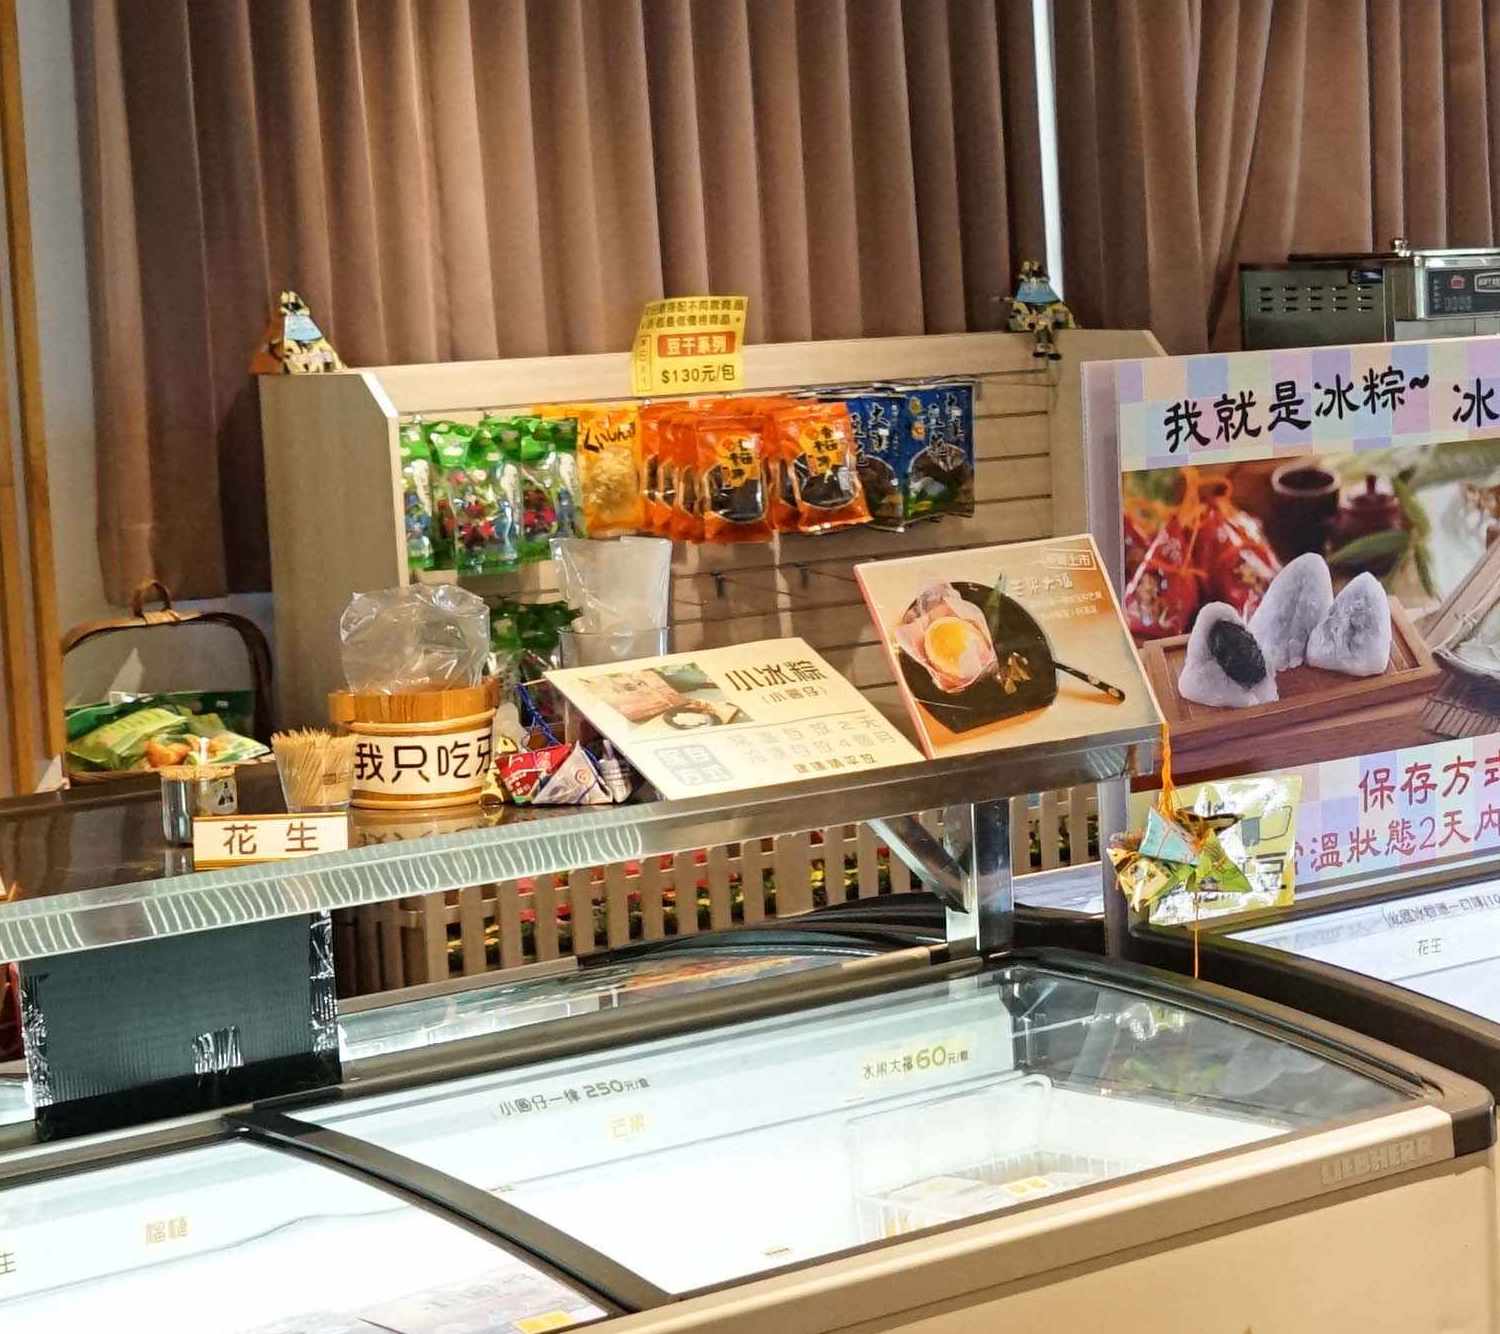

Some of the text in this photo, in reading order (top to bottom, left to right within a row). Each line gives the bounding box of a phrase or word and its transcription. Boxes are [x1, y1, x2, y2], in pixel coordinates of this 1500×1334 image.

[666, 335, 727, 356] 豆干系列
[661, 363, 736, 384] $130元/包
[724, 660, 829, 693] 小冰粽
[221, 821, 320, 856] 花生
[1415, 937, 1443, 957] 花生
